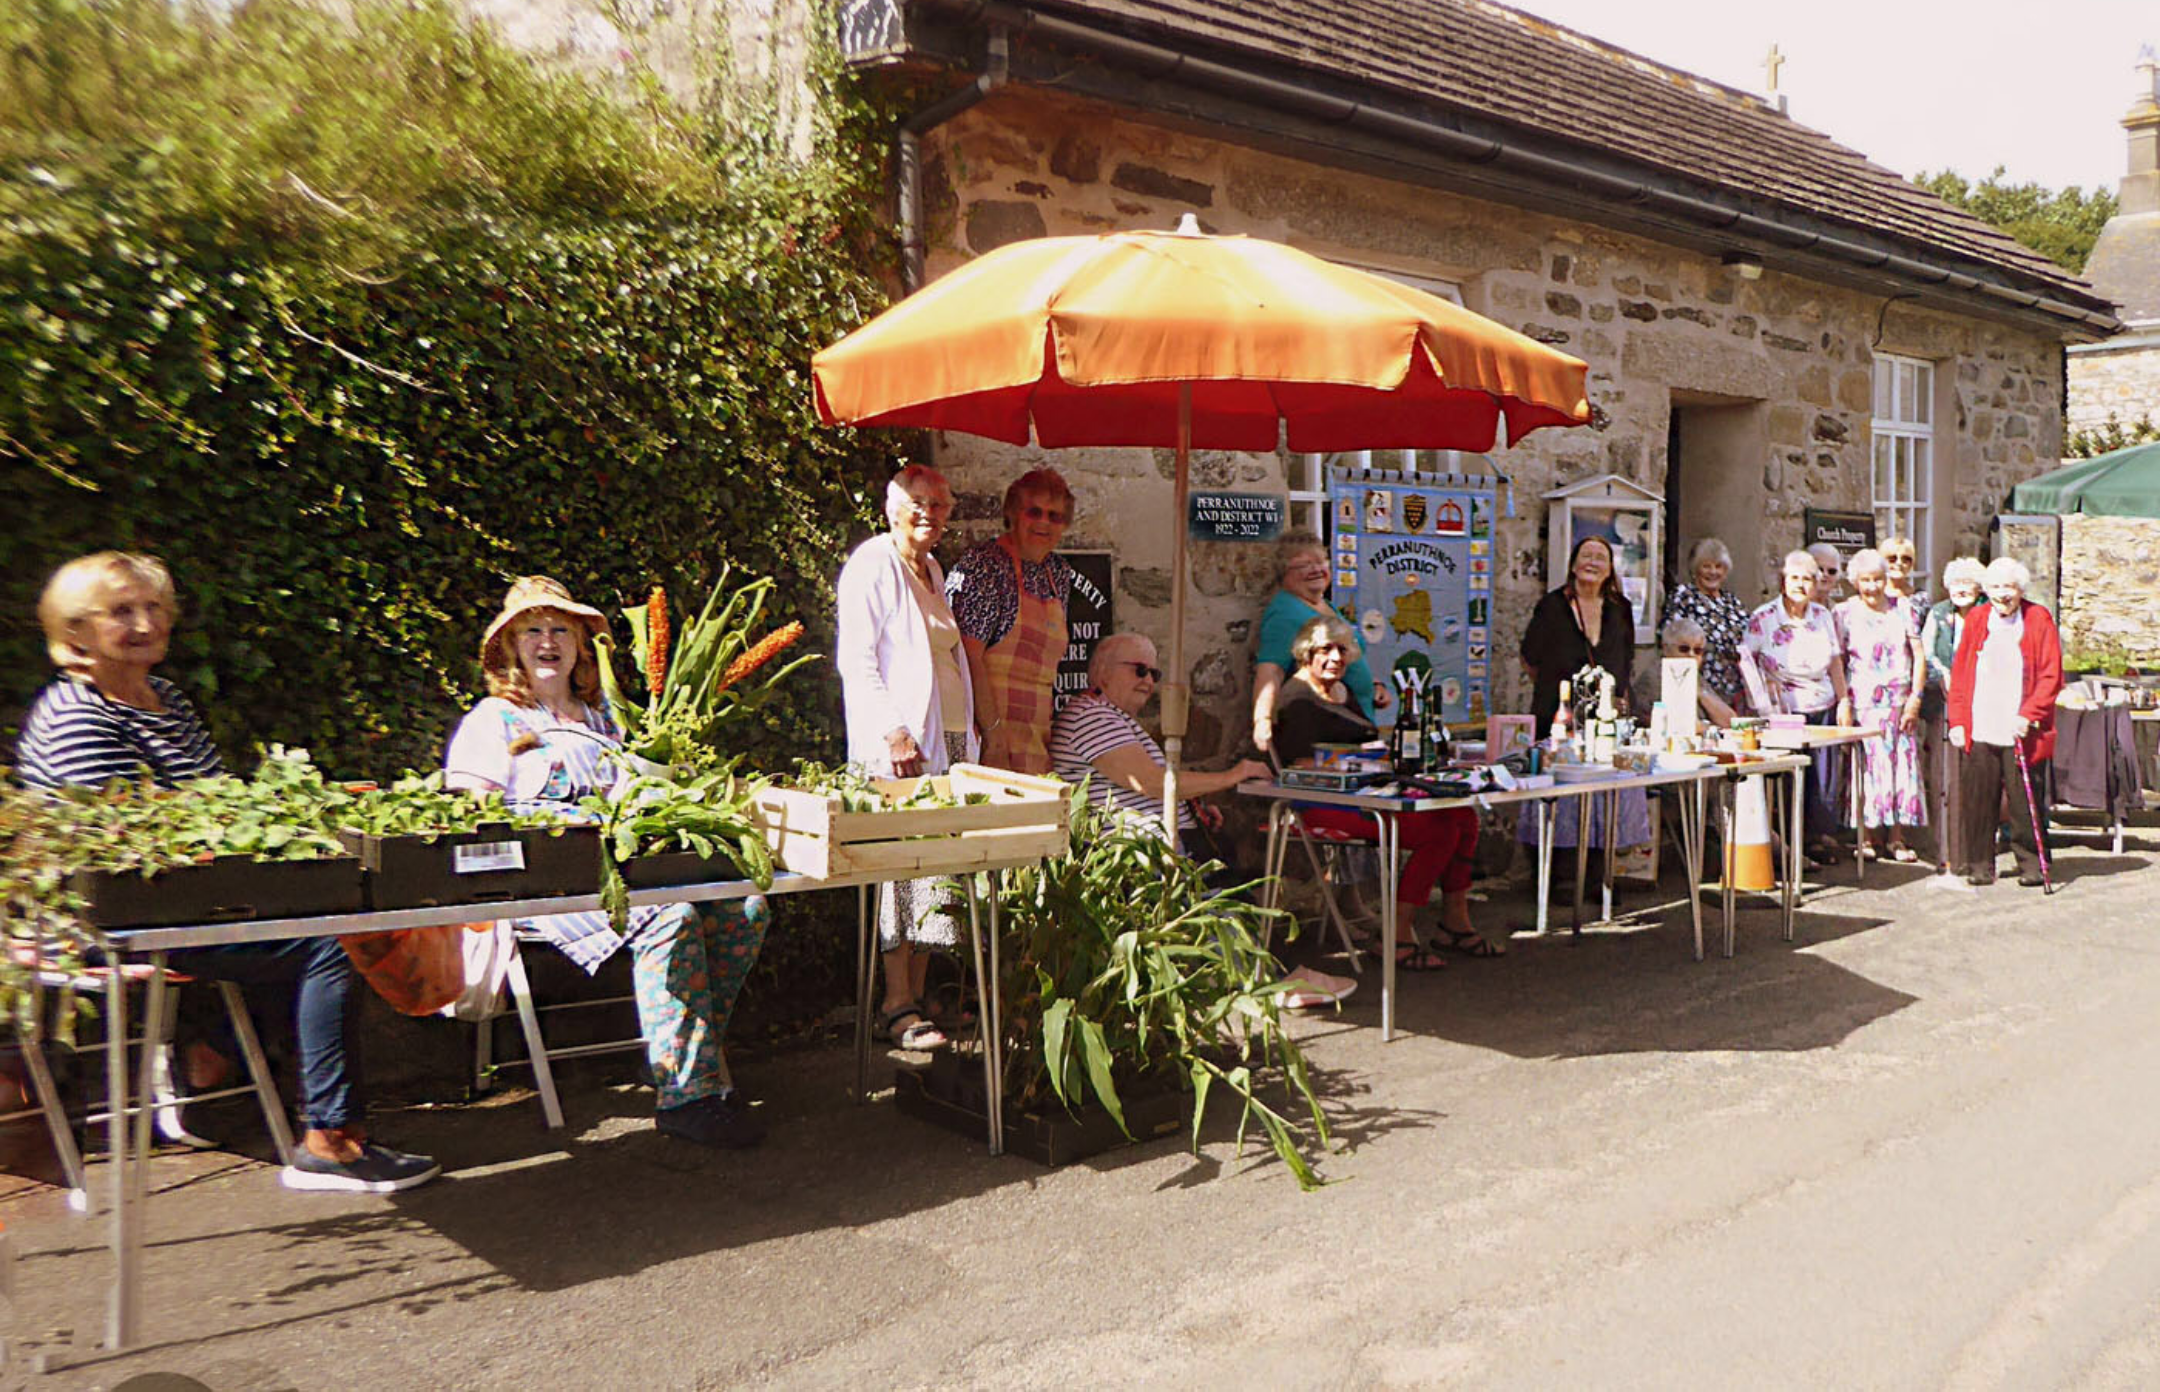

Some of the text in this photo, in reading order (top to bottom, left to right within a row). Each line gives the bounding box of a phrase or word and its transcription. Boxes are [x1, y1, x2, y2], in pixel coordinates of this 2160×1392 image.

[1196, 496, 1277, 510] PERRANUTHNOE
[1196, 510, 1219, 521] AND
[1220, 510, 1262, 522] DISTRICT
[1215, 523, 1234, 535] 1922
[1240, 524, 1260, 535] 2022
[1369, 540, 1457, 575] PERRANUTHNOE
[1386, 558, 1439, 576] DISTRICT
[1069, 568, 1107, 611] PERTY
[1072, 622, 1101, 640] NOT
[1054, 672, 1089, 694] QUIR
